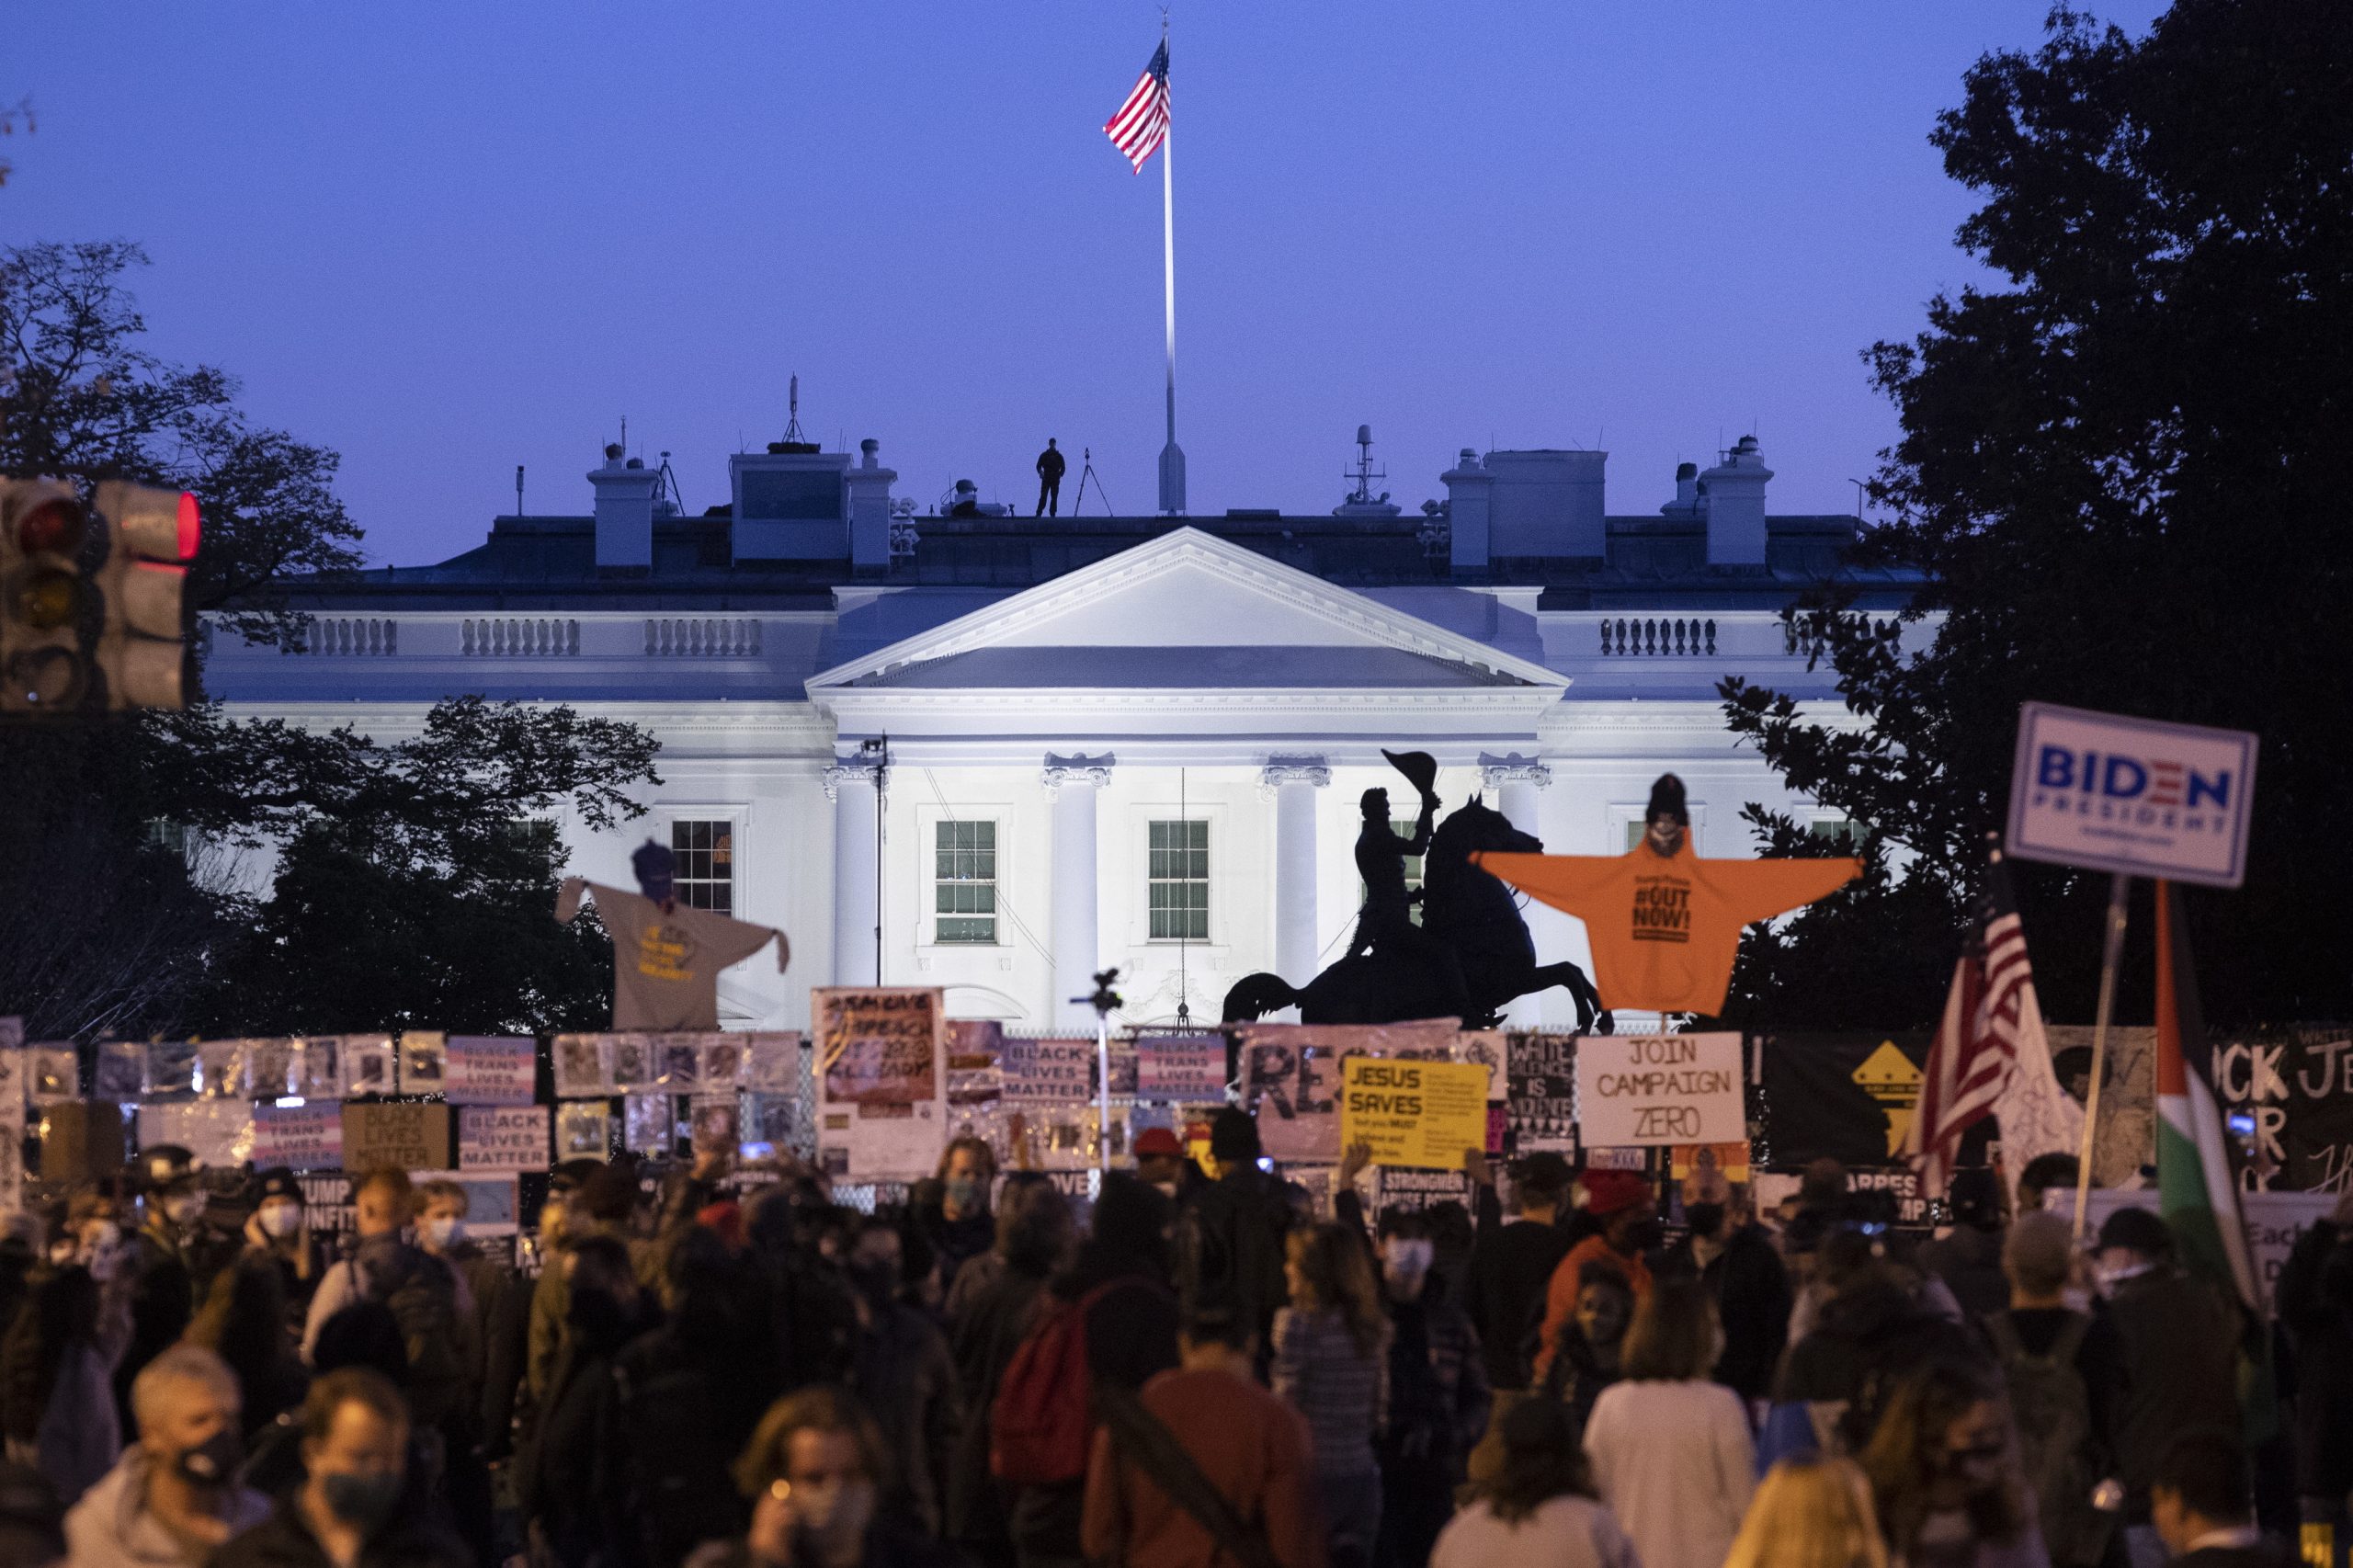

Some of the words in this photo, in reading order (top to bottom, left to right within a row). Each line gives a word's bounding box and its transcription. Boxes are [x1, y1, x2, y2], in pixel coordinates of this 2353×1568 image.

[2038, 744, 2231, 800] BIDEN
[1632, 907, 1690, 929] NOW!
[1013, 1046, 1083, 1060] BLACK
[1629, 1038, 1698, 1064] JOIN
[464, 1059, 519, 1071] TRANS
[1155, 1056, 1209, 1067] TRANS
[466, 1073, 516, 1085] LIVES
[1020, 1066, 1076, 1078] LIVES
[1157, 1070, 1206, 1081] LIVES
[1350, 1066, 1421, 1089] JESUS
[1006, 1084, 1085, 1096] MATTER
[1528, 1077, 1546, 1097] IS
[1597, 1070, 1731, 1097] CAMPAIGN
[1349, 1092, 1423, 1115] SAVES
[470, 1113, 540, 1129] BLACK
[1632, 1106, 1701, 1139] ZERO
[268, 1124, 325, 1136] TRANS
[273, 1139, 321, 1151] LIVES
[477, 1134, 535, 1147] LIVES
[464, 1151, 543, 1165] MATTER
[296, 1178, 351, 1204] UMP
[1051, 1174, 1089, 1196] VE
